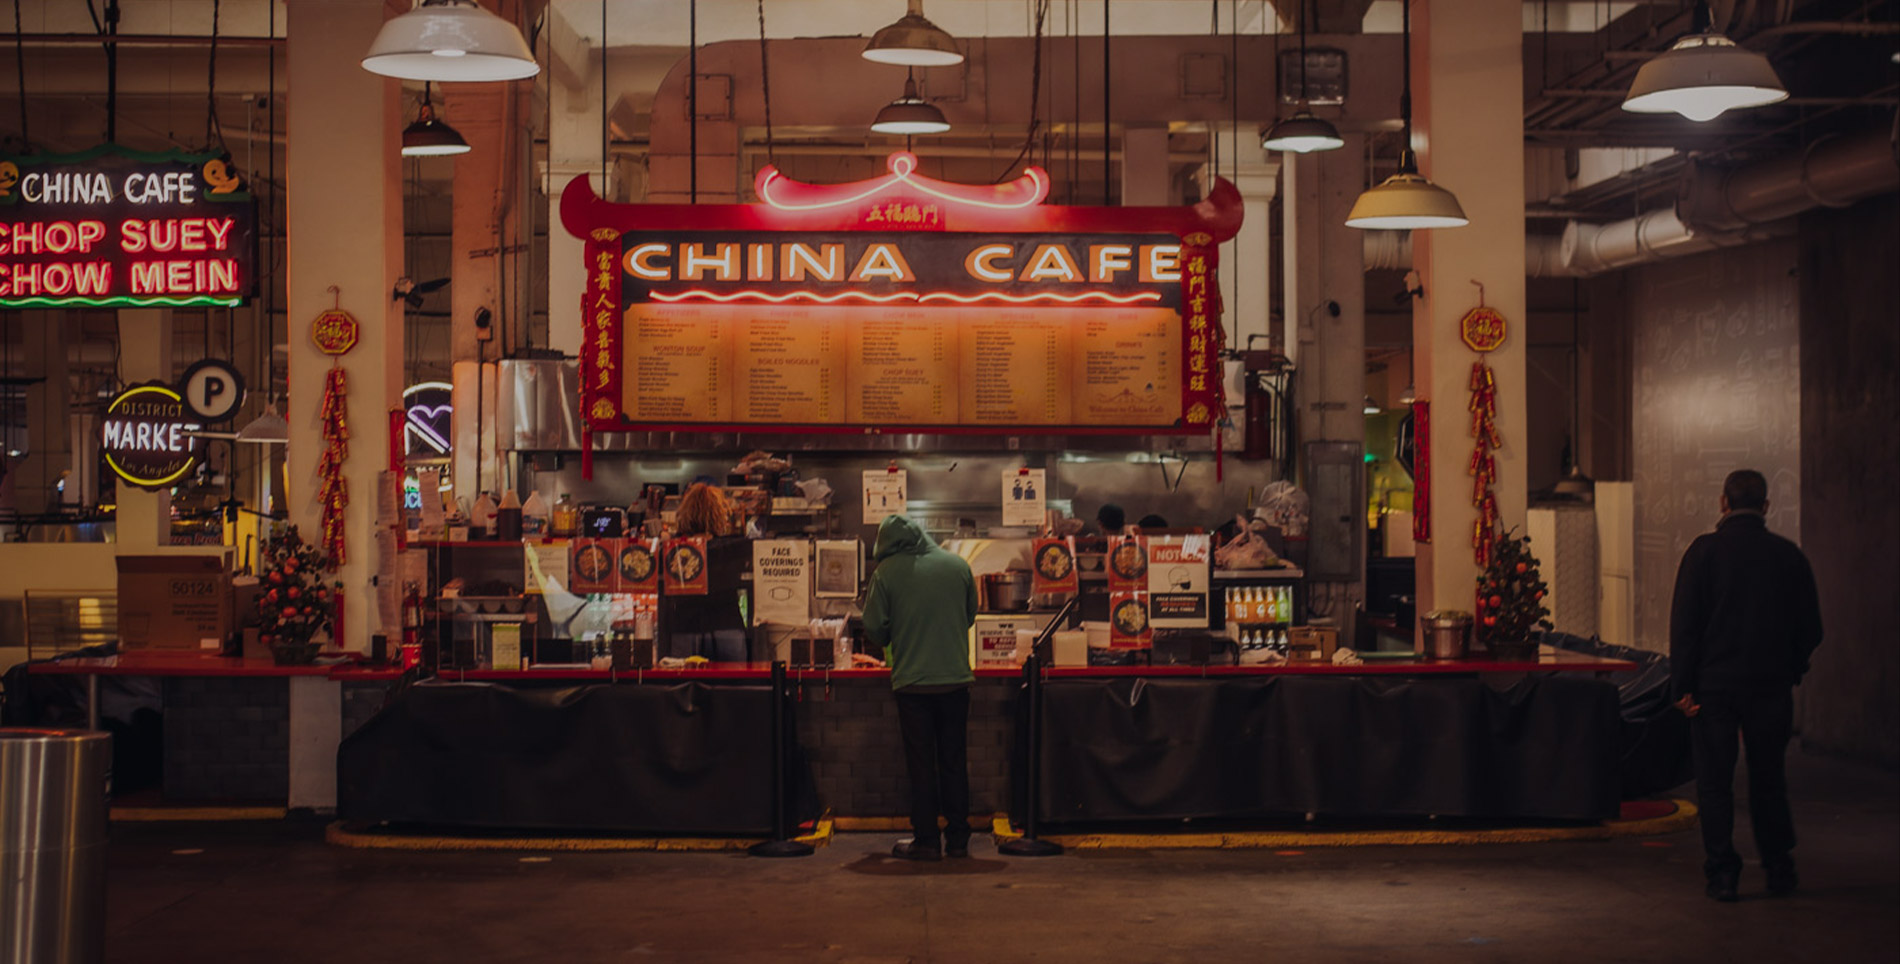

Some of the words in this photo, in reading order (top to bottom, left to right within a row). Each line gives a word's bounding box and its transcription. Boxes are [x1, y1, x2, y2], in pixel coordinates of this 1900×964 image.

[21, 173, 113, 204] CHINA
[123, 172, 197, 204] CAFE
[121, 217, 236, 253] SUEY
[622, 242, 917, 283] CHINA
[964, 243, 1183, 284] CAFE
[131, 259, 239, 294] MEIN
[653, 345, 685, 353] WONTON
[686, 345, 706, 353] SOUP
[882, 368, 904, 376] CHOP
[904, 368, 924, 376] SUEY
[204, 377, 224, 407] P
[122, 402, 183, 418] DISTRICT
[103, 420, 200, 452] MARKET
[120, 456, 137, 472] Los
[771, 547, 791, 557] FACE
[759, 557, 804, 567] COVERINGS
[762, 567, 801, 577] REQUIRED
[172, 582, 213, 595] 50124
